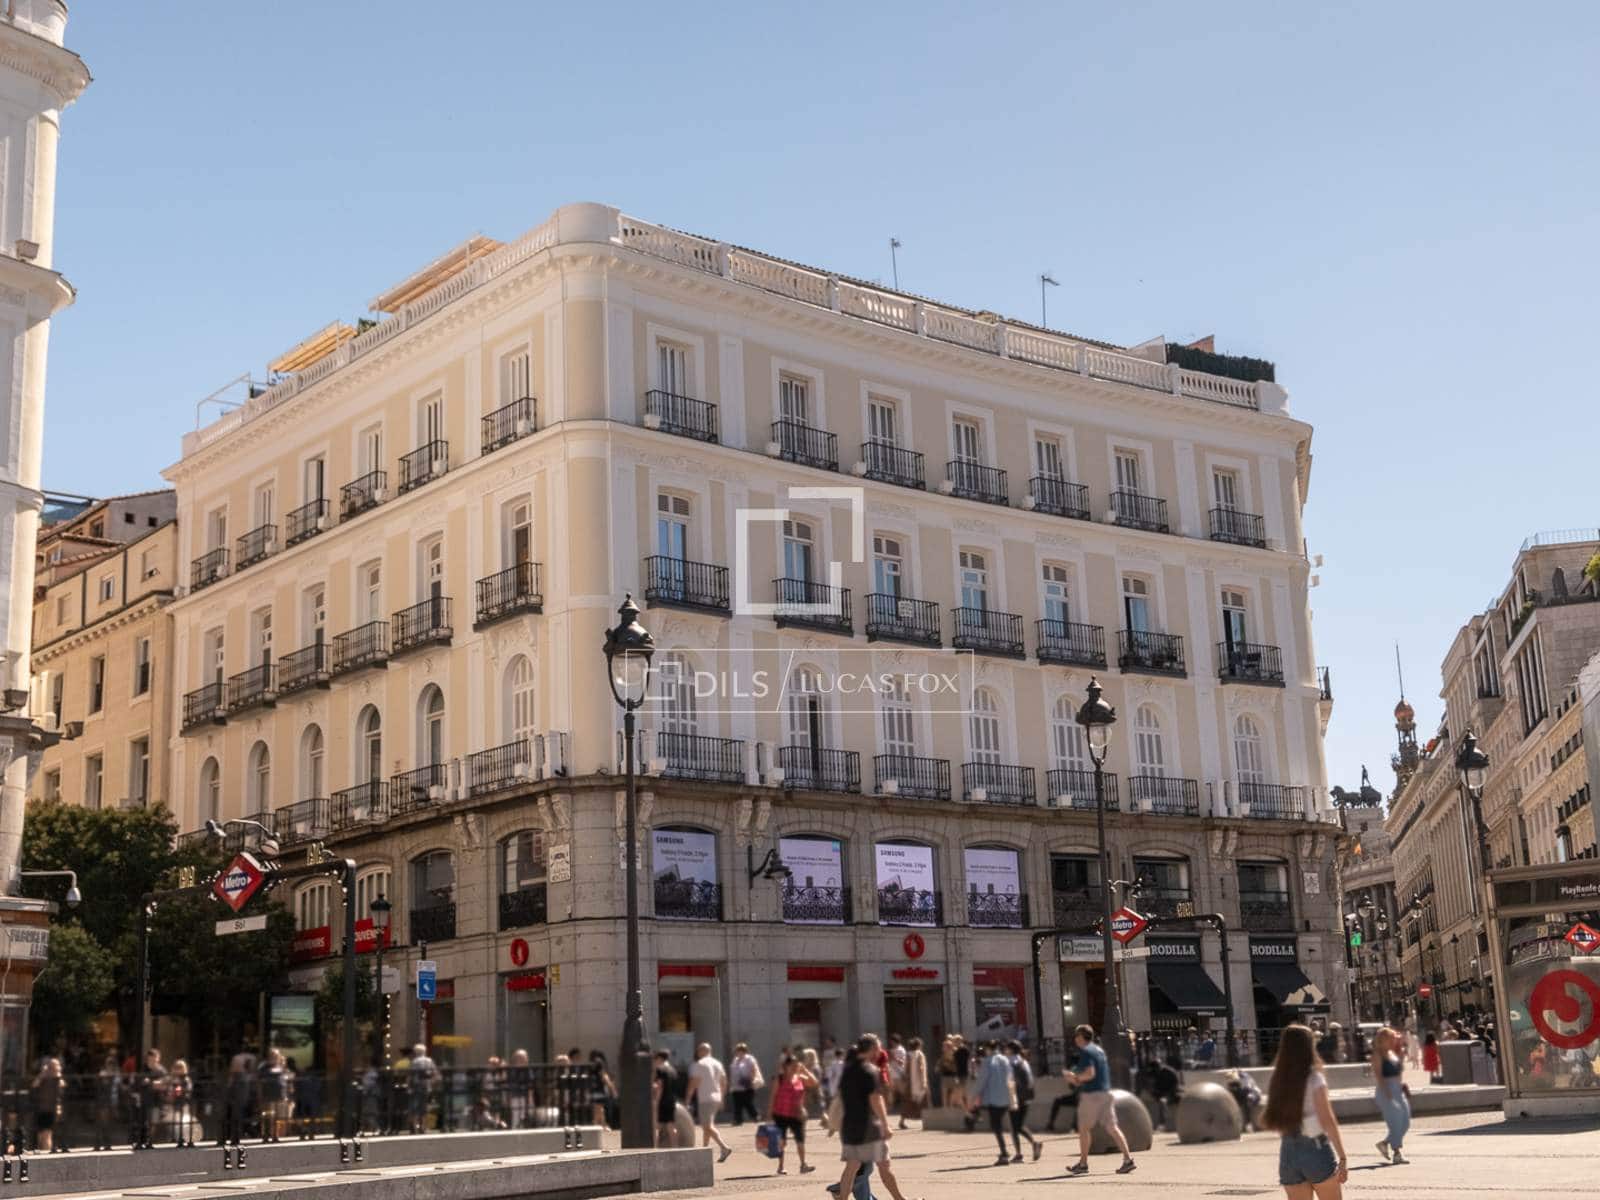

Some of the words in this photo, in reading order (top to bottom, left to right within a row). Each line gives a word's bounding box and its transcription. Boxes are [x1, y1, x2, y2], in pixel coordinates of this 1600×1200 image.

[656, 835, 684, 844] SAMSUNG
[880, 849, 905, 857] SAMSUNG
[225, 874, 247, 889] Metro
[234, 920, 246, 930] Sol
[1112, 920, 1133, 930] Metro
[1121, 948, 1133, 957] Sol
[1151, 944, 1196, 956] RODILLA
[1251, 945, 1295, 956] RODILLA
